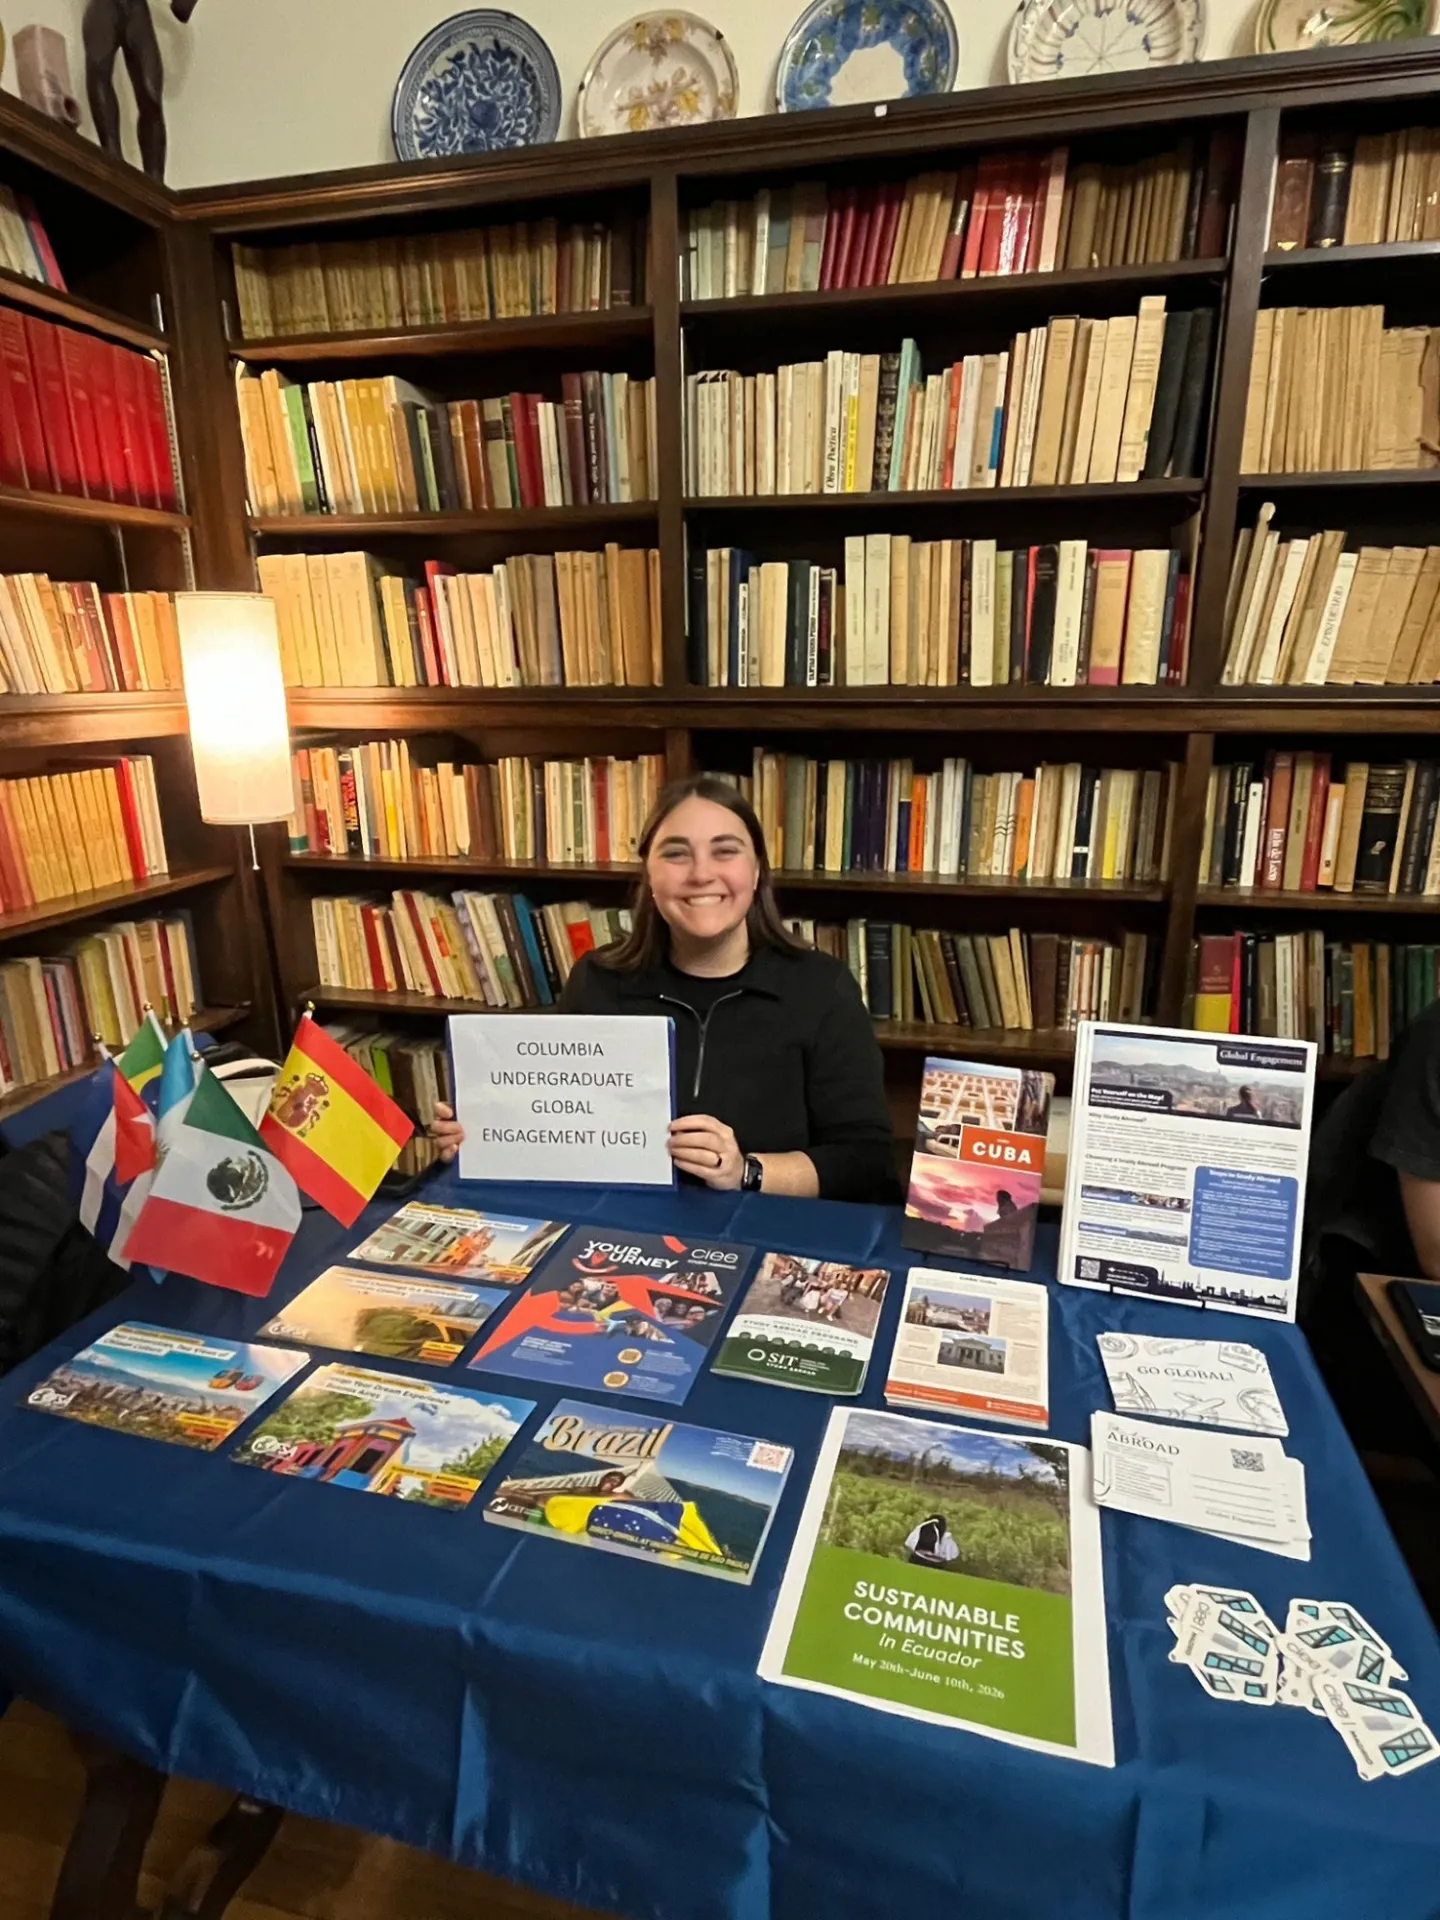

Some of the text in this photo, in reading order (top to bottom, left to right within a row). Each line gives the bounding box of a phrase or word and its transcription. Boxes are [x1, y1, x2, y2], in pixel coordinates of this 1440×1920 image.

[826, 462, 836, 489] Obra
[516, 1042, 604, 1056] COLUMBIA
[1219, 1050, 1303, 1067] Global Engagement
[490, 1071, 634, 1087] UNDERGRADUATE
[531, 1100, 614, 1114] GLOBAL
[482, 1128, 647, 1148] ENGAGEMENT (UGE)
[972, 1141, 1031, 1164] CUBA
[587, 1240, 642, 1256] YOUR
[768, 1352, 799, 1366] SIT
[1137, 1366, 1235, 1382] GO GLOBAL!
[542, 1415, 674, 1459] Brazil
[1107, 1432, 1180, 1456] ABROAD
[854, 1580, 1020, 1634] SUSTAINABLE
[843, 1602, 1026, 1659] COMMUNITIES
[879, 1633, 982, 1669] in Ecuador
[852, 1652, 877, 1671] May
